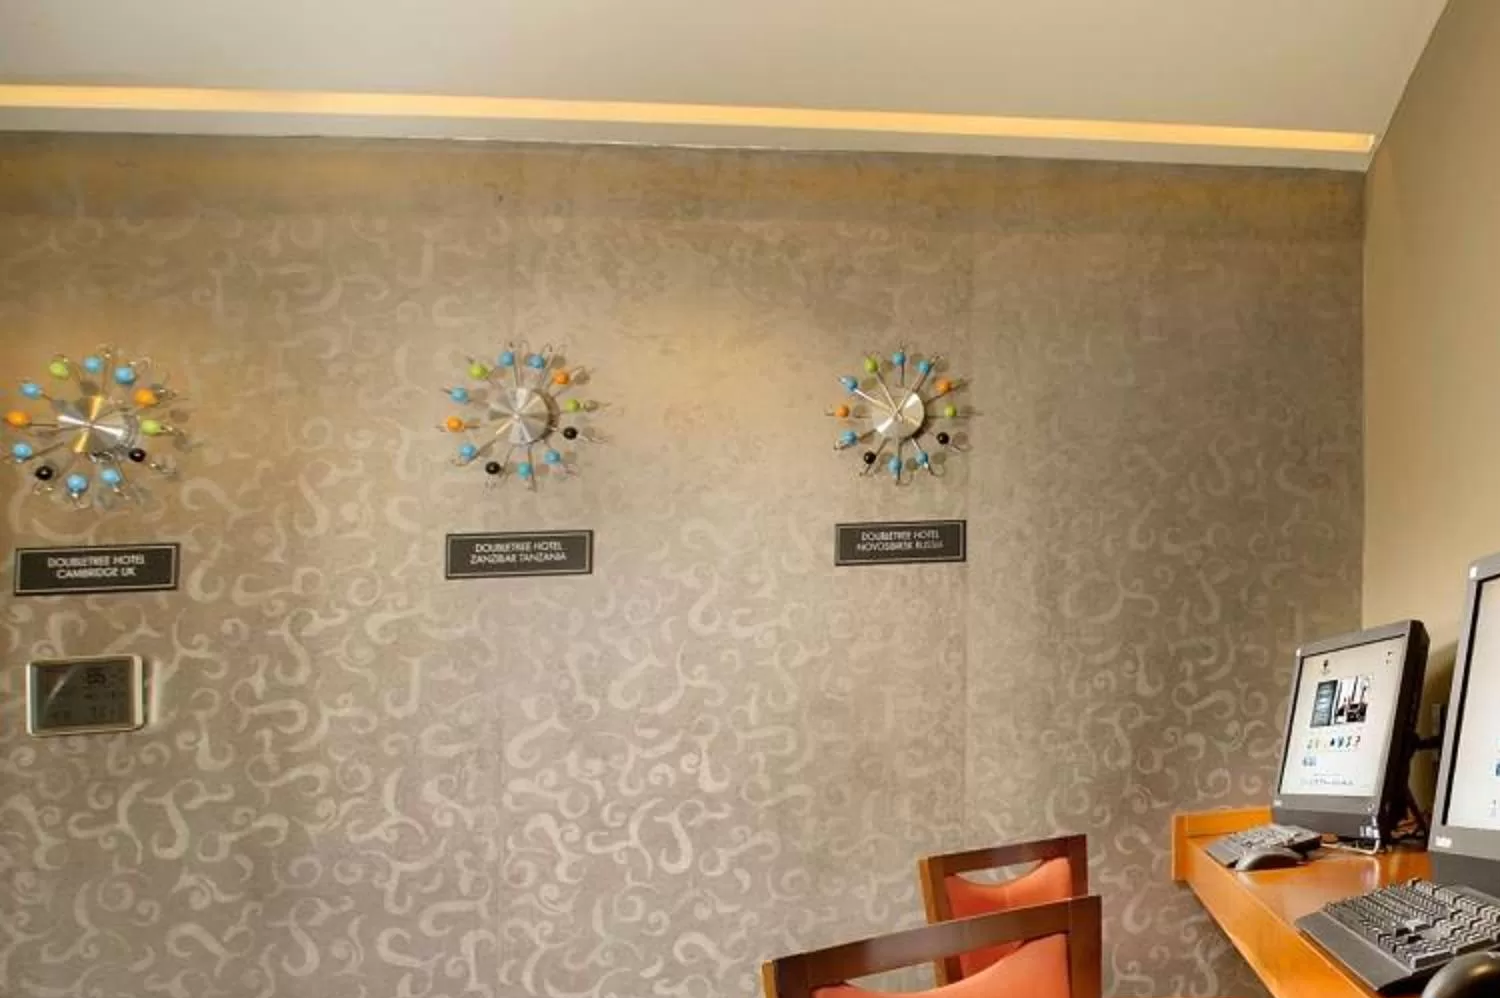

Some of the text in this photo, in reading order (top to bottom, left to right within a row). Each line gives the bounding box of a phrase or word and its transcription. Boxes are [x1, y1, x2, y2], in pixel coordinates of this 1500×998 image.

[534, 540, 562, 551] HOTEL
[48, 553, 145, 568] DOUBLETREE HOTEL
[56, 566, 136, 579] CAMBRIDGE UK
